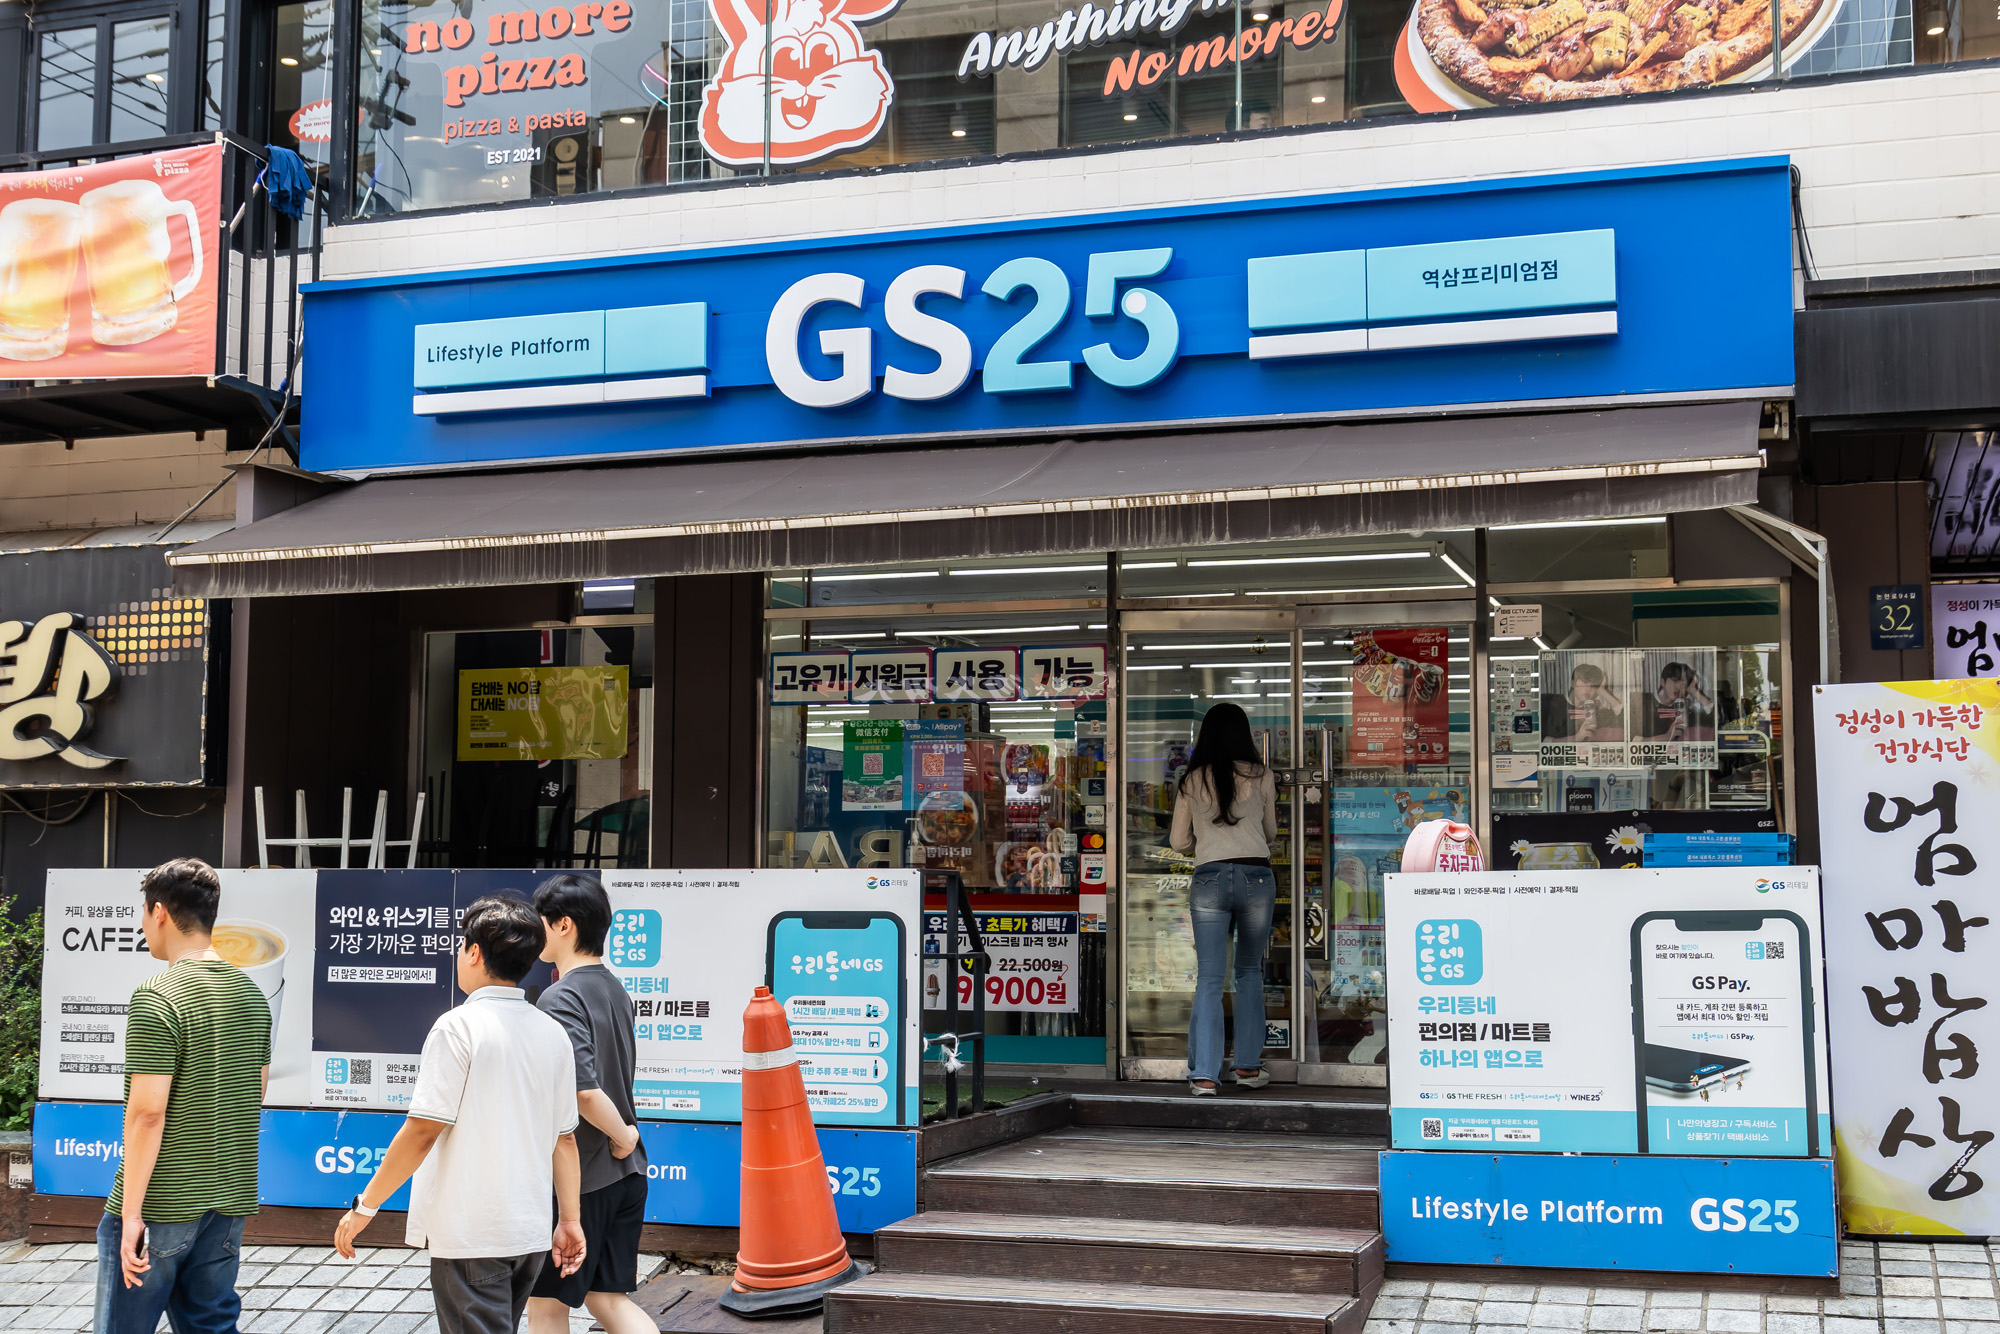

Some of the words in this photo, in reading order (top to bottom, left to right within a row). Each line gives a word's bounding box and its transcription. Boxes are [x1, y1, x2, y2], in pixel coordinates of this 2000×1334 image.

[406, 17, 475, 54] no
[487, 0, 633, 46] more
[1104, 49, 1175, 96] No
[1177, 0, 1346, 76] more!
[443, 52, 588, 107] pizza
[445, 117, 502, 144] pizza
[508, 118, 519, 132] &
[525, 108, 587, 136] pasta
[487, 151, 511, 164] EST
[513, 147, 541, 162] 2021
[164, 167, 189, 176] pizza
[1421, 259, 1559, 290] 역삼프리미엄점
[764, 246, 1182, 409] GS25
[427, 343, 503, 364] Lifestyle
[511, 337, 590, 357] Platform
[1947, 600, 1980, 611] 정성이
[1879, 604, 1914, 631] 32
[776, 664, 848, 691] 고유가
[946, 659, 1007, 690] 사용
[1033, 657, 1094, 689] 가능
[471, 681, 503, 696] 담배는
[470, 697, 505, 711] 대세는
[1835, 708, 1905, 736] 정성이
[1911, 704, 1984, 733] 가득한
[855, 728, 889, 737] 微信支付
[1874, 736, 1971, 765] 건강식단
[1350, 771, 1396, 782] Lifestyle
[1569, 792, 1592, 804] ploom
[1440, 853, 1480, 872] 주차금지
[879, 879, 890, 887] GS
[891, 879, 908, 887] 리테일
[1414, 887, 1455, 895] 바로배달·픽업
[1464, 886, 1506, 895] 와인주문·픽업
[1514, 886, 1541, 894] 사전예약
[1549, 886, 1579, 894] 결제·적립
[1771, 881, 1785, 890] GS
[1786, 881, 1809, 890] 리테일
[65, 905, 85, 918] 커피,
[87, 905, 114, 918] 일상을
[116, 906, 135, 918] 담다
[329, 906, 363, 928] 와인
[365, 907, 380, 927] &
[382, 906, 451, 929] 위스키를
[614, 913, 645, 932] 우리
[986, 917, 1028, 932] 초특가
[1031, 917, 1067, 932] 혜택!
[1023, 936, 1043, 947] 파격
[1046, 936, 1068, 947] 행사
[1420, 923, 1459, 945] 우리
[329, 932, 363, 954] 가장
[366, 933, 417, 955] 가까운
[1655, 943, 1679, 951] 찾으시는
[627, 948, 647, 961] GS
[1688, 952, 1715, 960] 있습니다.
[790, 950, 883, 981] 우리동네GS
[998, 958, 1063, 973] 22,500원
[1440, 963, 1464, 978] GS
[331, 968, 339, 979] 더
[341, 968, 357, 980] 많은
[359, 969, 384, 980] 와인은
[385, 969, 432, 981] 모바일에서!
[1692, 976, 1715, 990] GS
[1718, 976, 1751, 993] Pay.
[1862, 779, 1997, 1203] 엄마밥상
[62, 1004, 78, 1013] 스위스
[111, 1005, 123, 1014] 커피
[664, 1000, 710, 1017] 마트를
[792, 1007, 810, 1016] 1시간
[1418, 996, 1496, 1015] 우리동네
[1676, 1003, 1684, 1011] 내
[1686, 1003, 1703, 1012] 카드,
[1704, 1003, 1719, 1011] 계좌
[1721, 1003, 1736, 1011] 간편
[1738, 1003, 1768, 1012] 등록하고
[1676, 1013, 1699, 1021] 앱에서
[1700, 1013, 1715, 1021] 최대
[1717, 1013, 1734, 1021] 10%
[1735, 1013, 1769, 1021] 할인·적립
[62, 1023, 72, 1031] 국내
[657, 1023, 703, 1041] 앱으로
[1418, 1022, 1477, 1042] 편의점
[1491, 1022, 1551, 1042] 마트를
[61, 1033, 82, 1042] 스페셜티
[101, 1033, 113, 1042] 원두
[793, 1037, 807, 1046] 최대
[808, 1038, 824, 1046] 10%
[1741, 1033, 1755, 1041] Pay.
[61, 1053, 82, 1061] 합리적인
[83, 1054, 105, 1062] 가격으로
[1419, 1048, 1478, 1069] 하나의
[1483, 1049, 1544, 1069] 앱으로
[60, 1063, 78, 1072] 24시간
[91, 1064, 97, 1073] 수
[98, 1064, 109, 1073] 있는
[816, 1067, 831, 1075] 주류
[833, 1067, 867, 1076] 주문·픽업
[386, 1075, 407, 1084] 앱으로
[1677, 1119, 1728, 1128] 나만의냉장고
[1734, 1119, 1777, 1128] 구독서비스
[1686, 1132, 1720, 1141] 상품찾기
[1727, 1133, 1770, 1141] 택배서비스
[1411, 1196, 1529, 1227] Lifestyle
[1541, 1199, 1664, 1226] Platform
[1690, 1196, 1800, 1234] GS25
